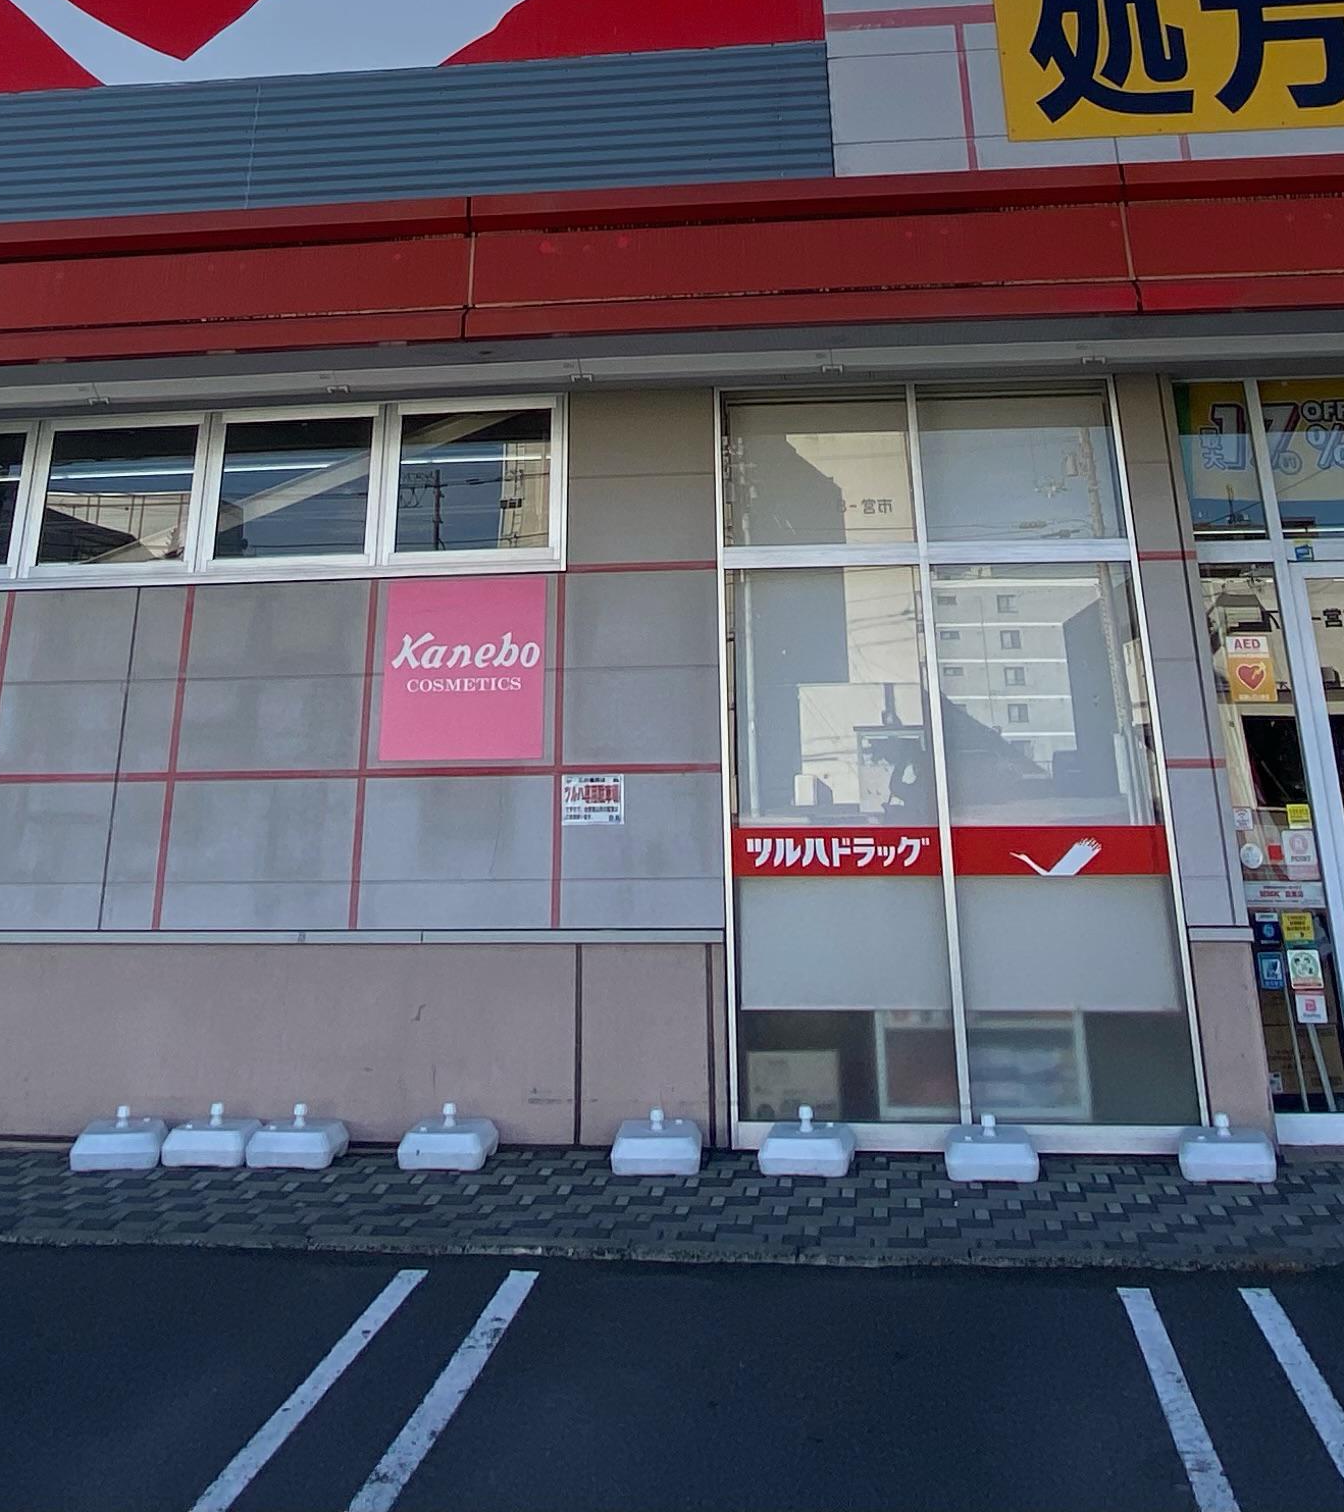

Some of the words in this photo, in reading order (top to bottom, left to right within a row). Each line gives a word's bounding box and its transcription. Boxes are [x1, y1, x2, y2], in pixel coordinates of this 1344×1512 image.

[391, 631, 541, 670] Kanebo
[1233, 639, 1262, 650] AED
[406, 676, 522, 693] COSMETICS
[745, 836, 930, 869] ツルハドラッグ
